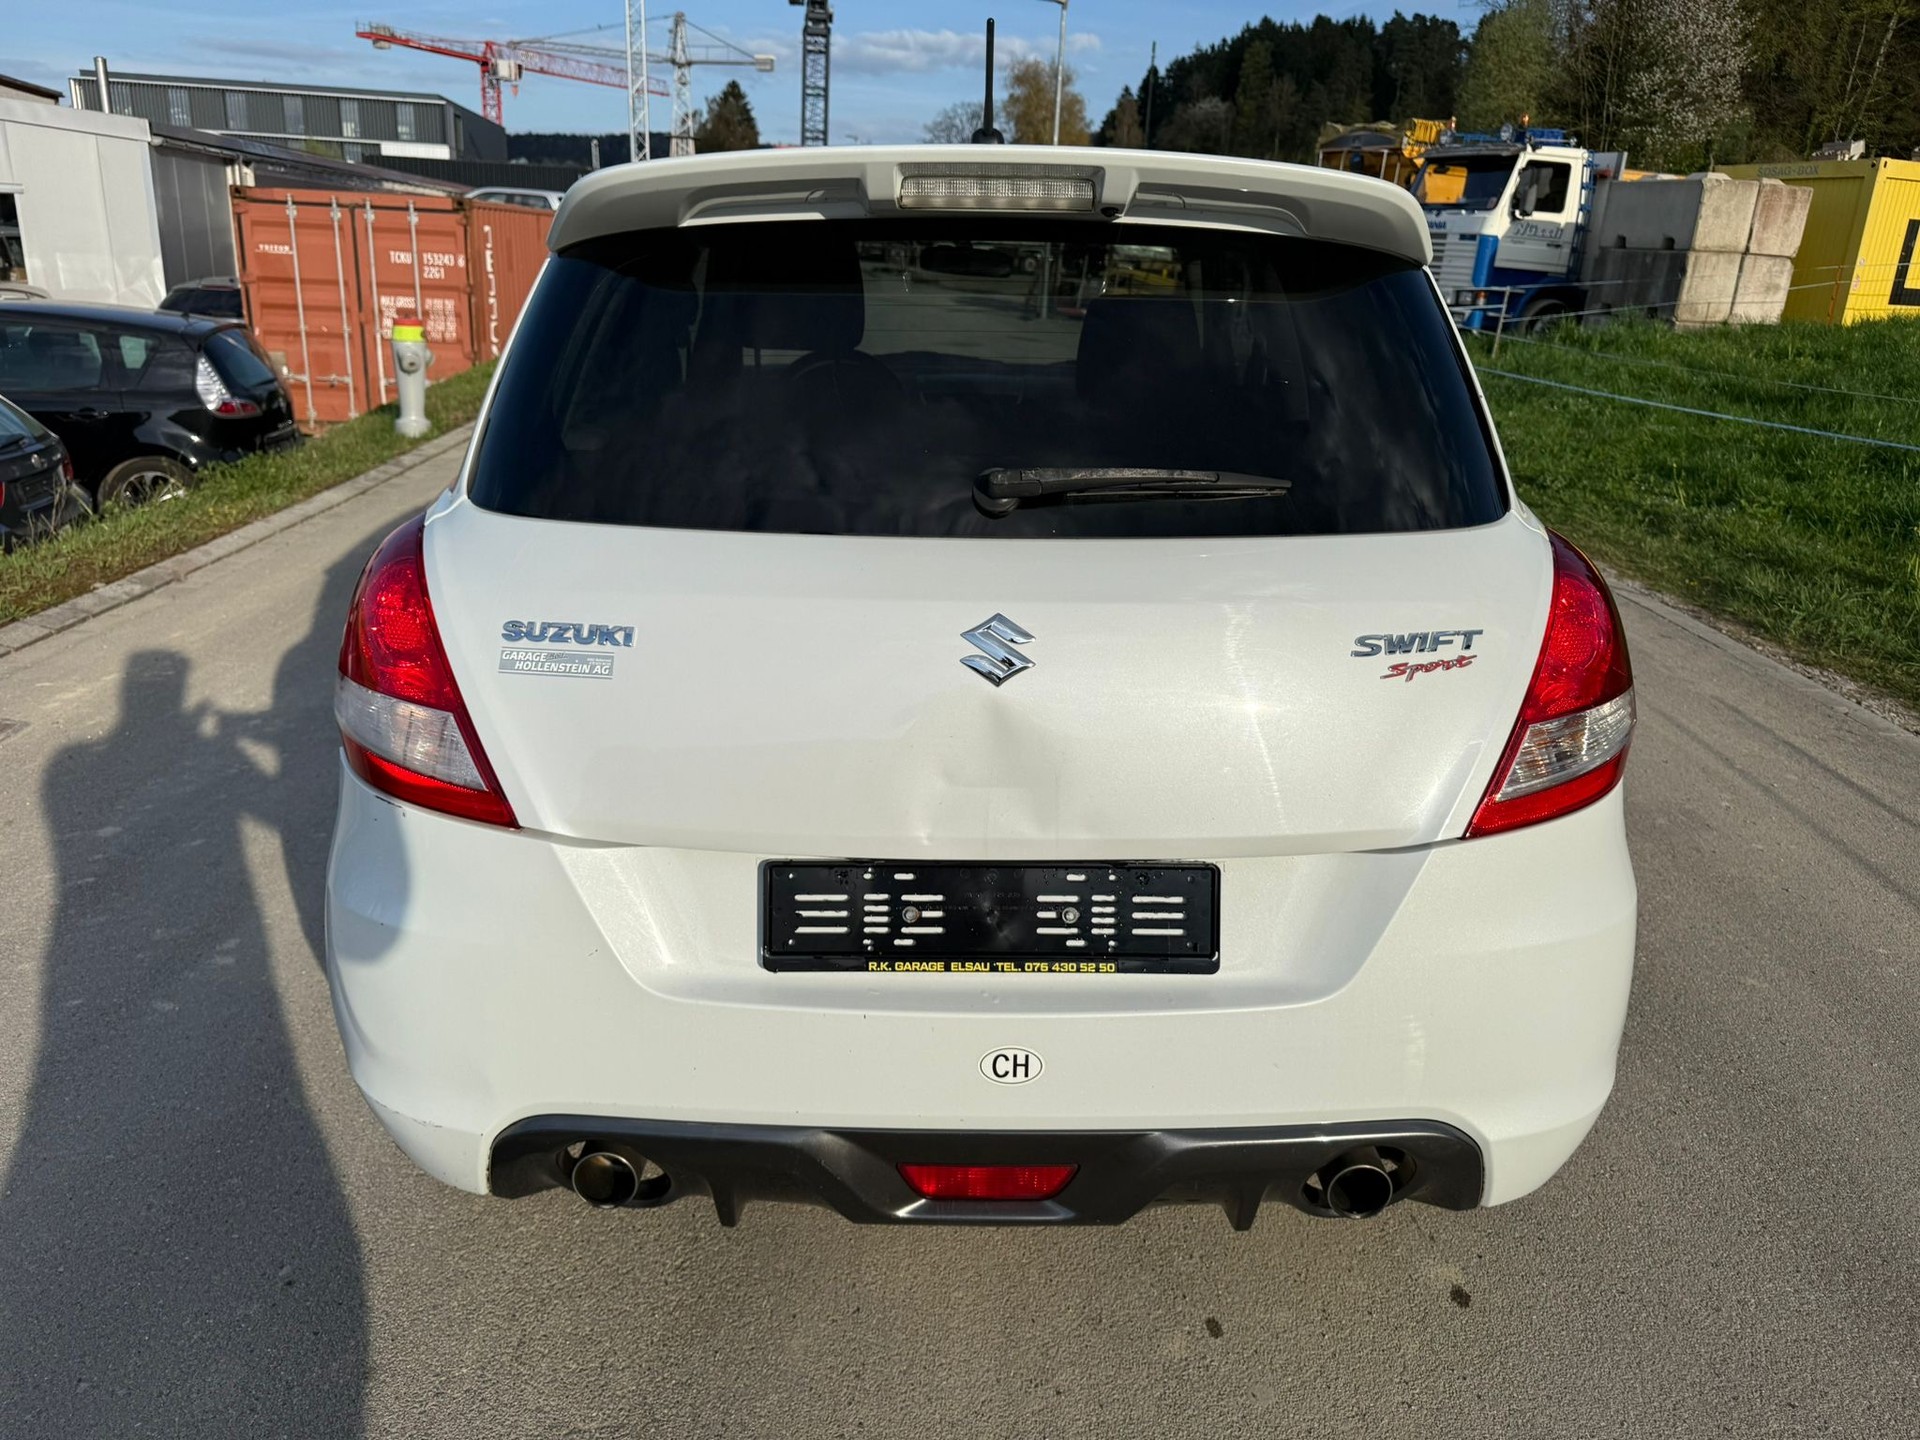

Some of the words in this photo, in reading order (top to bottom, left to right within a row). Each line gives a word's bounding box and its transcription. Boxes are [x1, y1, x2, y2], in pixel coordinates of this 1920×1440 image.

[389, 250, 413, 265] TCKU
[422, 252, 455, 267] 153243
[501, 620, 636, 648] SUZUKI
[1350, 629, 1484, 658] SWIFT
[502, 650, 548, 662] GARAGE
[514, 661, 591, 675] HOLLENSTEIN
[593, 665, 610, 675] AG
[1380, 654, 1478, 683] Sport
[868, 961, 892, 972] R.K.
[895, 961, 945, 972] GARAGE
[951, 962, 990, 972] ELSAU
[1024, 962, 1049, 973] 076
[1052, 963, 1077, 973] 430
[1080, 963, 1096, 973] 52
[1099, 963, 1115, 973] 50
[992, 1053, 1030, 1078] CH
